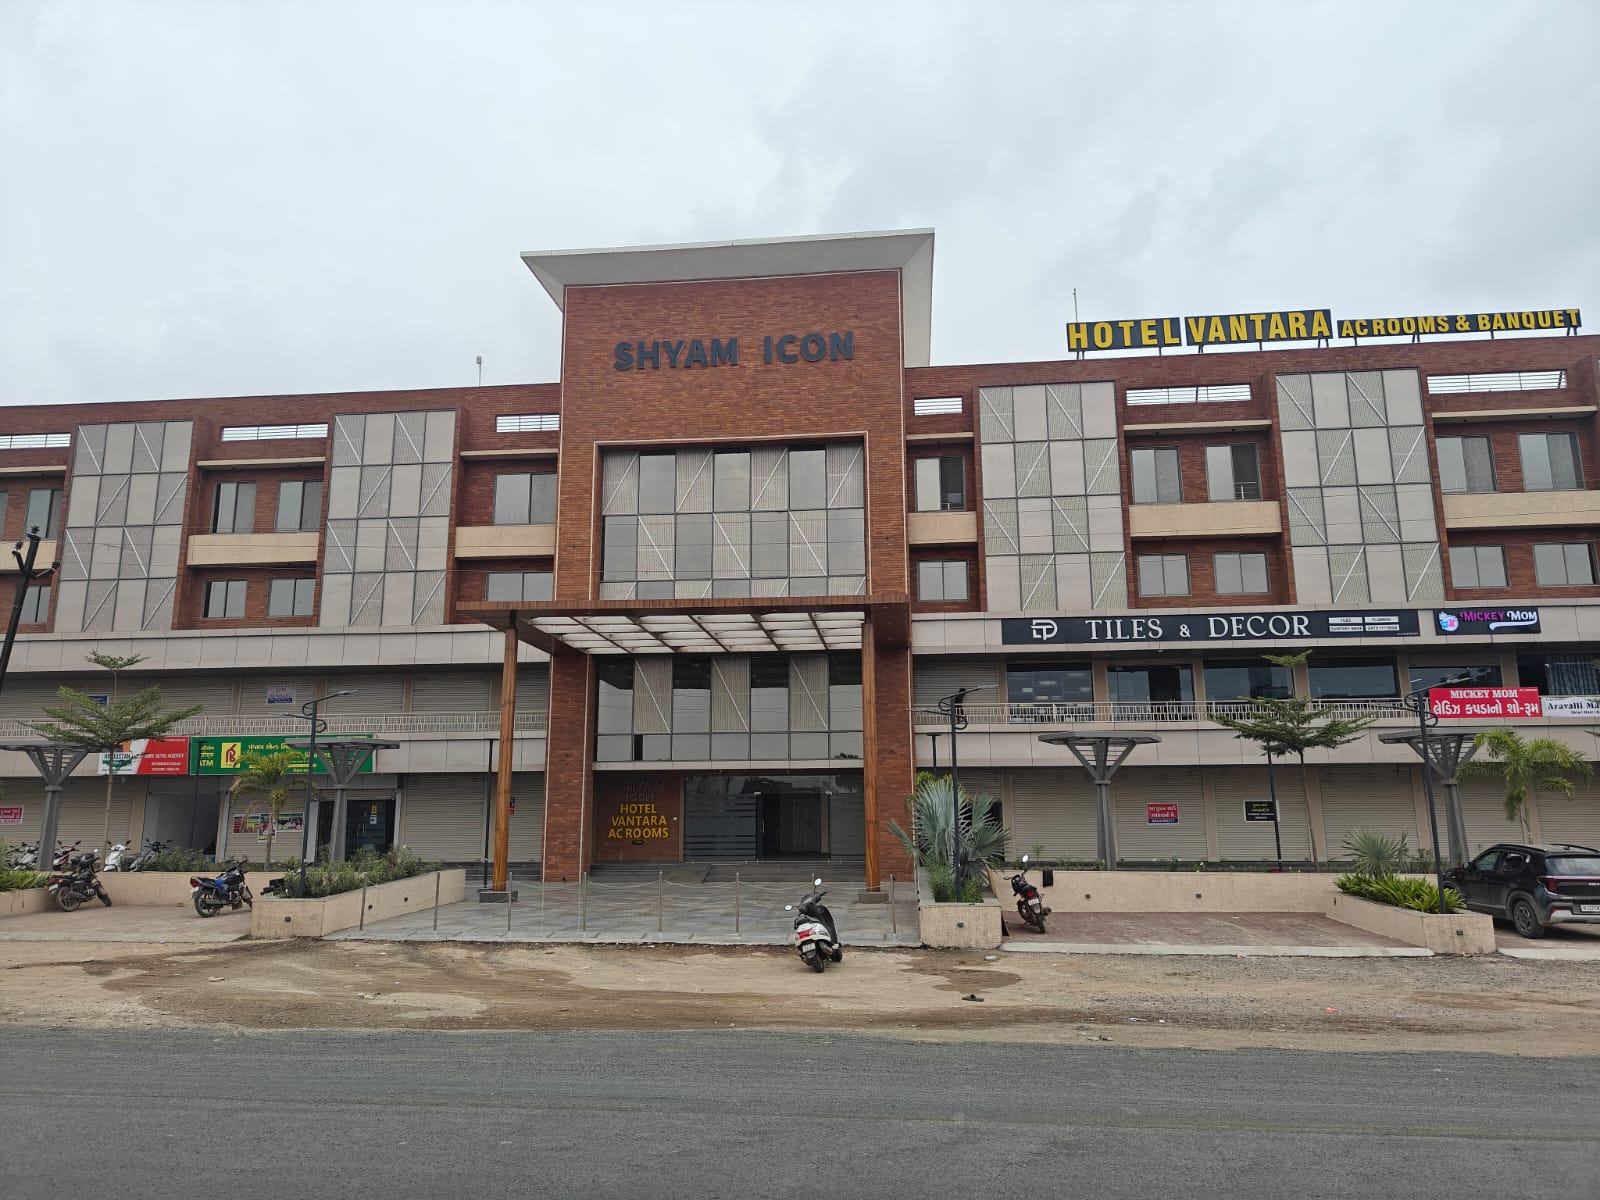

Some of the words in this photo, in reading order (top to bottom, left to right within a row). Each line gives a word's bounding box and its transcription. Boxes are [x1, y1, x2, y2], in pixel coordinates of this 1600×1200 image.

[1068, 319, 1180, 349] HOTEL
[1187, 310, 1330, 343] VANTARA
[1341, 319, 1369, 337] AC
[1372, 315, 1449, 336] ROOMS
[1455, 314, 1471, 331] &
[1477, 309, 1579, 331] BANQUET
[613, 336, 739, 370] SHYAM
[763, 331, 854, 364] ICON
[1460, 610, 1504, 622] MICKEY
[1085, 618, 1163, 640] TILES
[1179, 624, 1191, 638] &
[1208, 615, 1312, 638] DECOR
[1450, 689, 1489, 699] MICKEY
[1492, 689, 1518, 698] MOM
[1433, 699, 1461, 715] લેડિઝ
[1465, 699, 1502, 715] કપડાનો
[1506, 699, 1539, 716] શો-રૂમ
[1548, 702, 1583, 710] Aravalli
[620, 803, 657, 814] HOTEL
[611, 815, 667, 827] VANTARA
[608, 828, 623, 839] AC
[625, 827, 669, 839] ROOMS
